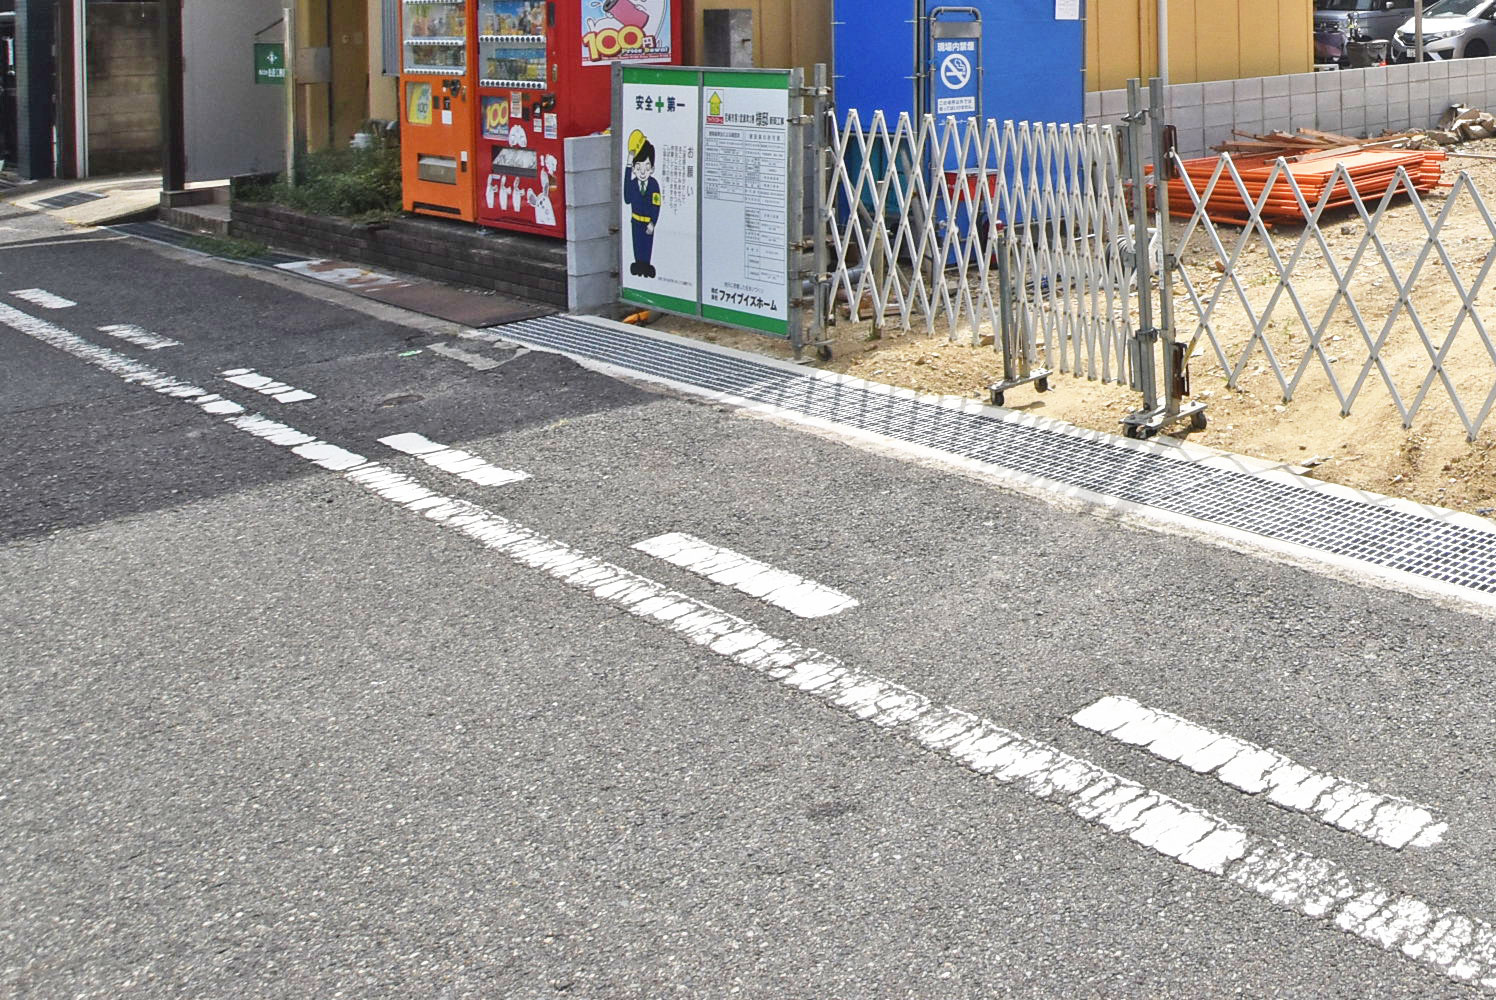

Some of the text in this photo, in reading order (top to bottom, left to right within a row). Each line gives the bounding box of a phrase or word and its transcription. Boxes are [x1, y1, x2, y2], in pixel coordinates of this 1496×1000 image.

[635, 95, 685, 113] 安全 第一
[719, 290, 777, 311] ファイブイズホーム
